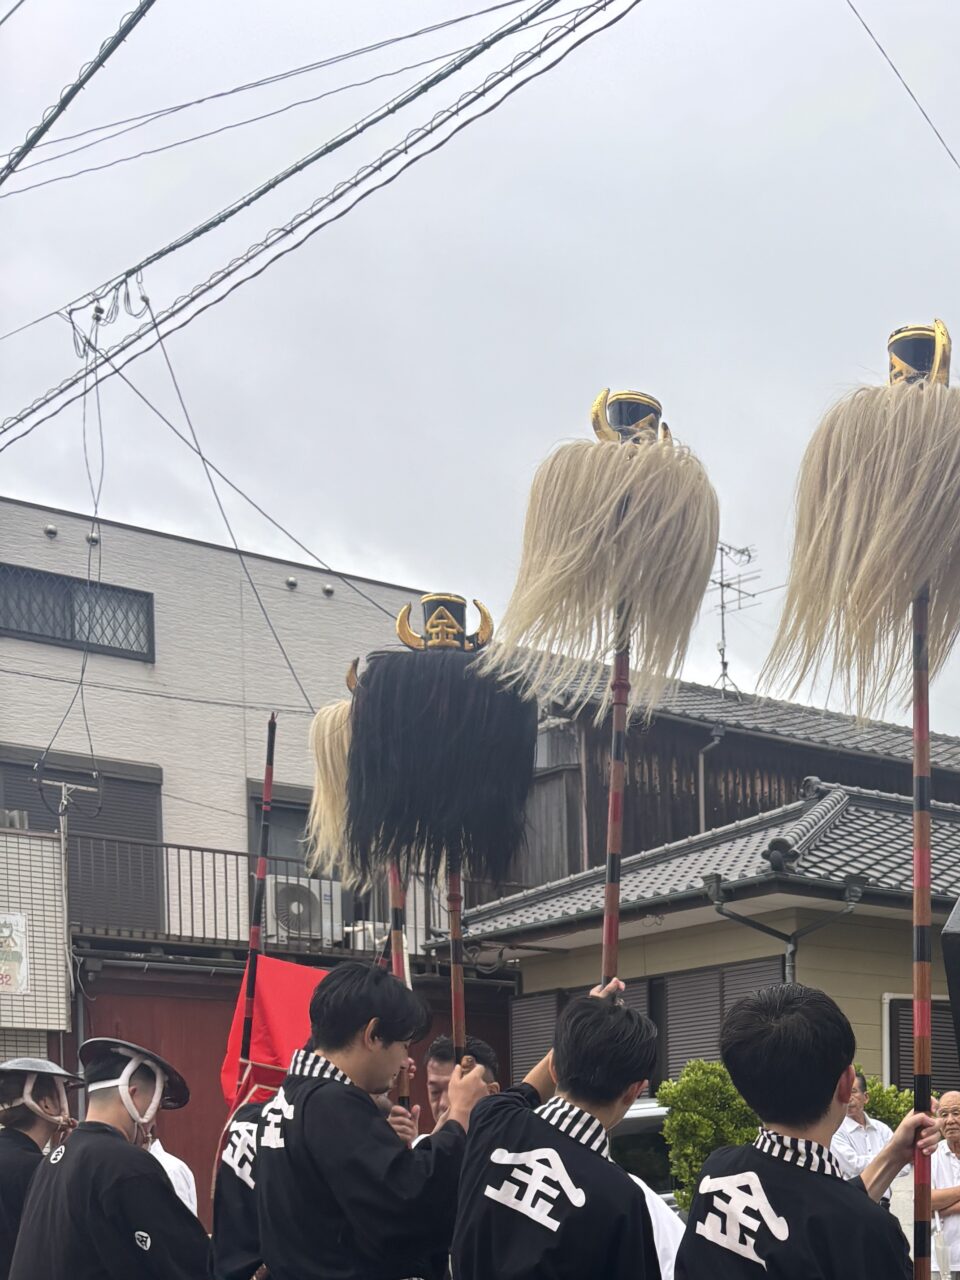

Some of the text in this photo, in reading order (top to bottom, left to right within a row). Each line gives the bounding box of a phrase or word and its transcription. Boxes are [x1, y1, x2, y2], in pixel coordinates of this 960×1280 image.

[426, 606, 464, 647] 金
[484, 1147, 586, 1232] 金
[695, 1170, 790, 1270] 金
